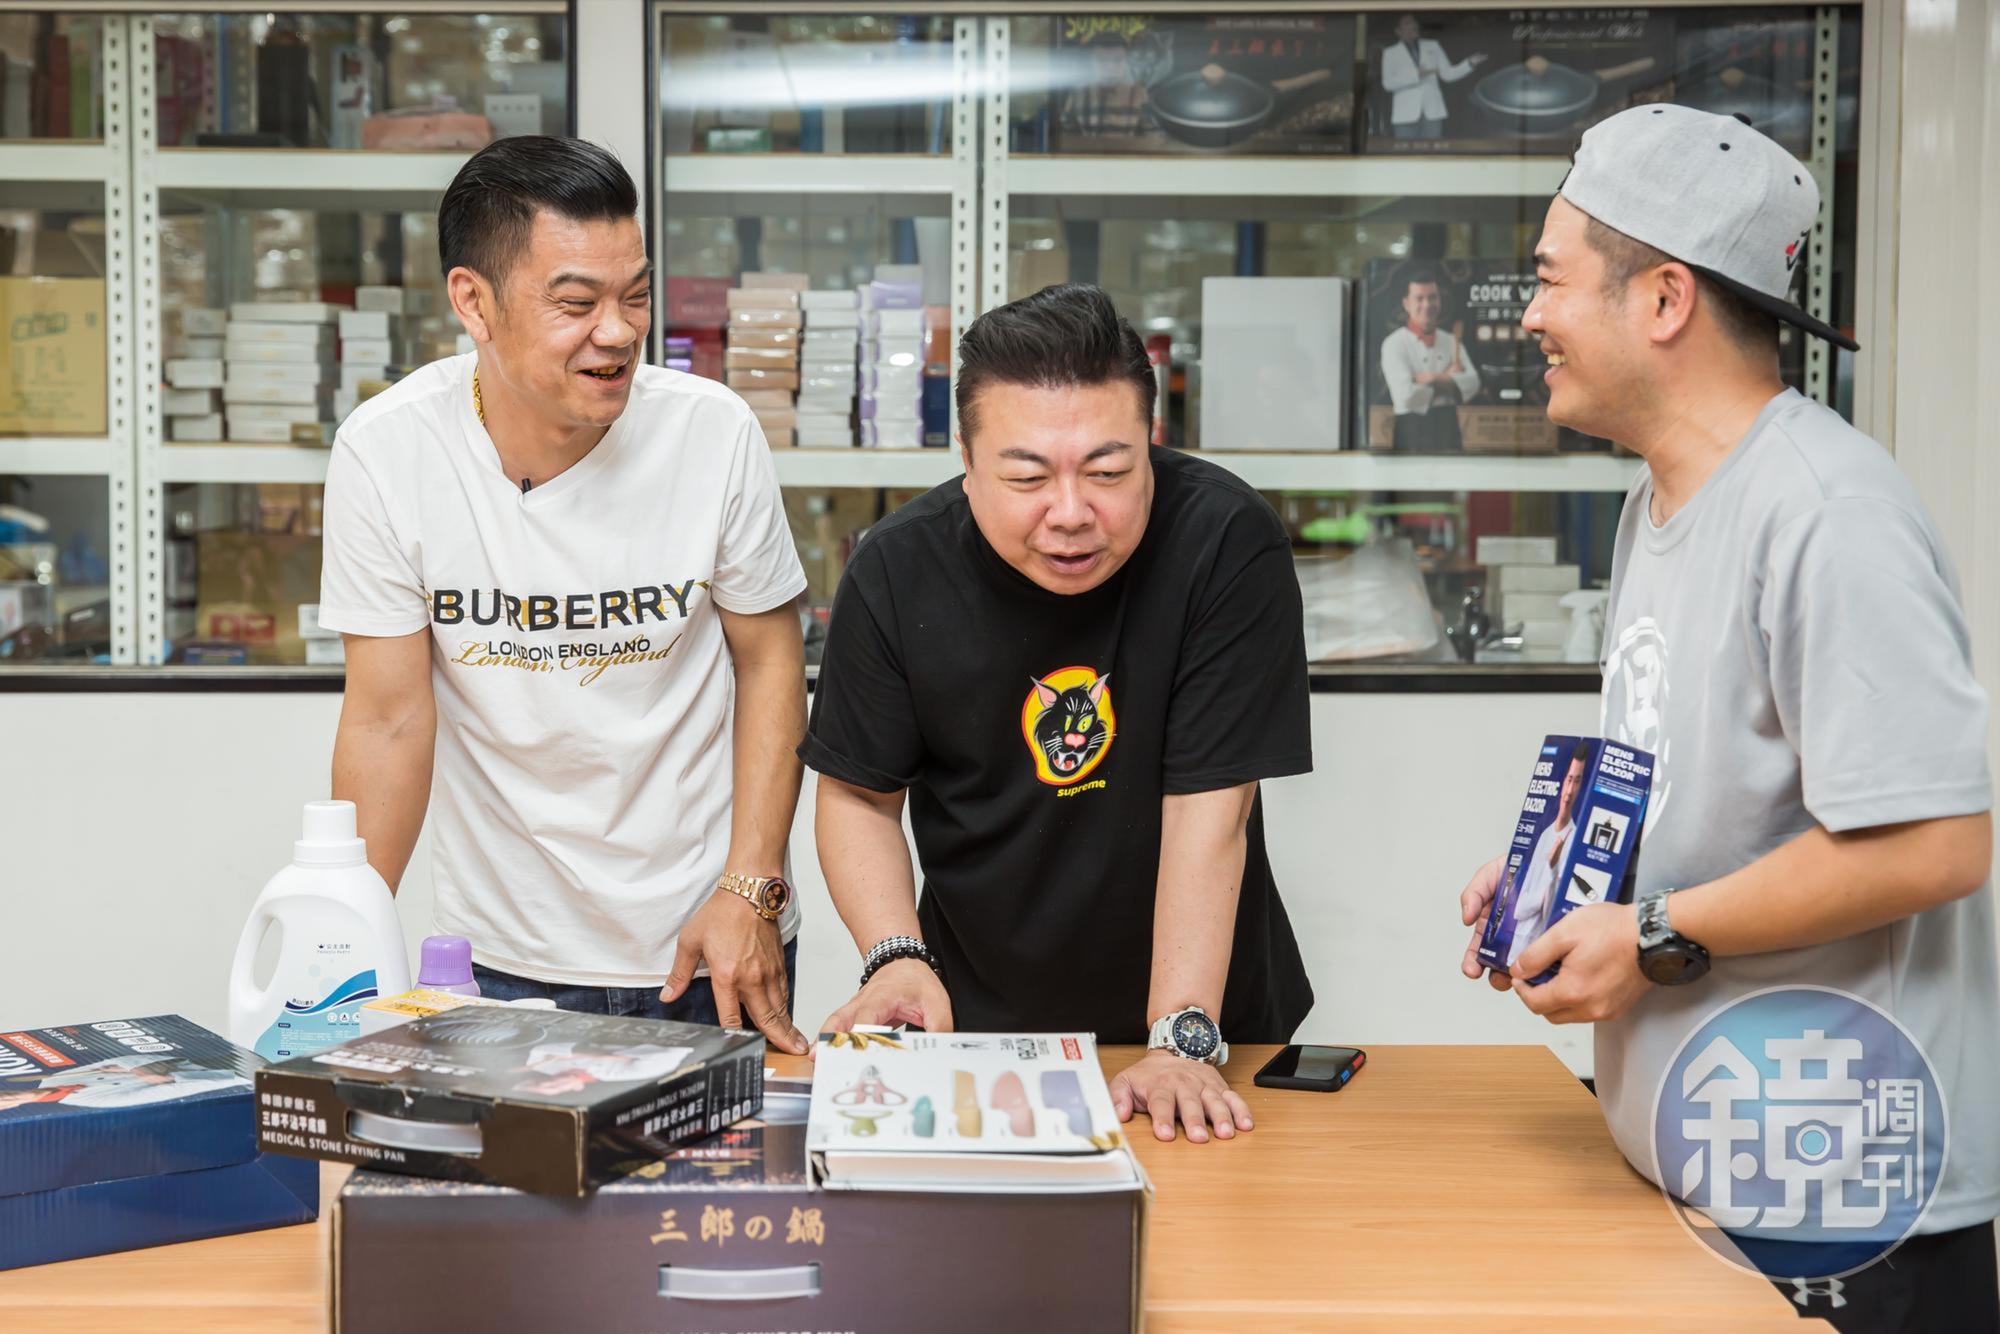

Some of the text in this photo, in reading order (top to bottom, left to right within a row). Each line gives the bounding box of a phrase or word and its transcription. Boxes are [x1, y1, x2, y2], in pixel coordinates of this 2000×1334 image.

[1470, 283, 1513, 302] COOK
[433, 579, 695, 632] BURBERRY
[488, 640, 554, 661] LONDON
[1604, 745, 1635, 761] MENS
[1534, 761, 1554, 777] MENS
[1598, 763, 1635, 782] RAZOR
[1601, 754, 1651, 777] ELECTRIC
[1057, 779, 1106, 797] supreme
[1528, 779, 1561, 797] ELECTRIC
[1523, 796, 1547, 814] RAZOR
[262, 1131, 406, 1163] MEDICAL STONE FRYING PAN
[649, 1203, 826, 1248] 三郎の鍋
